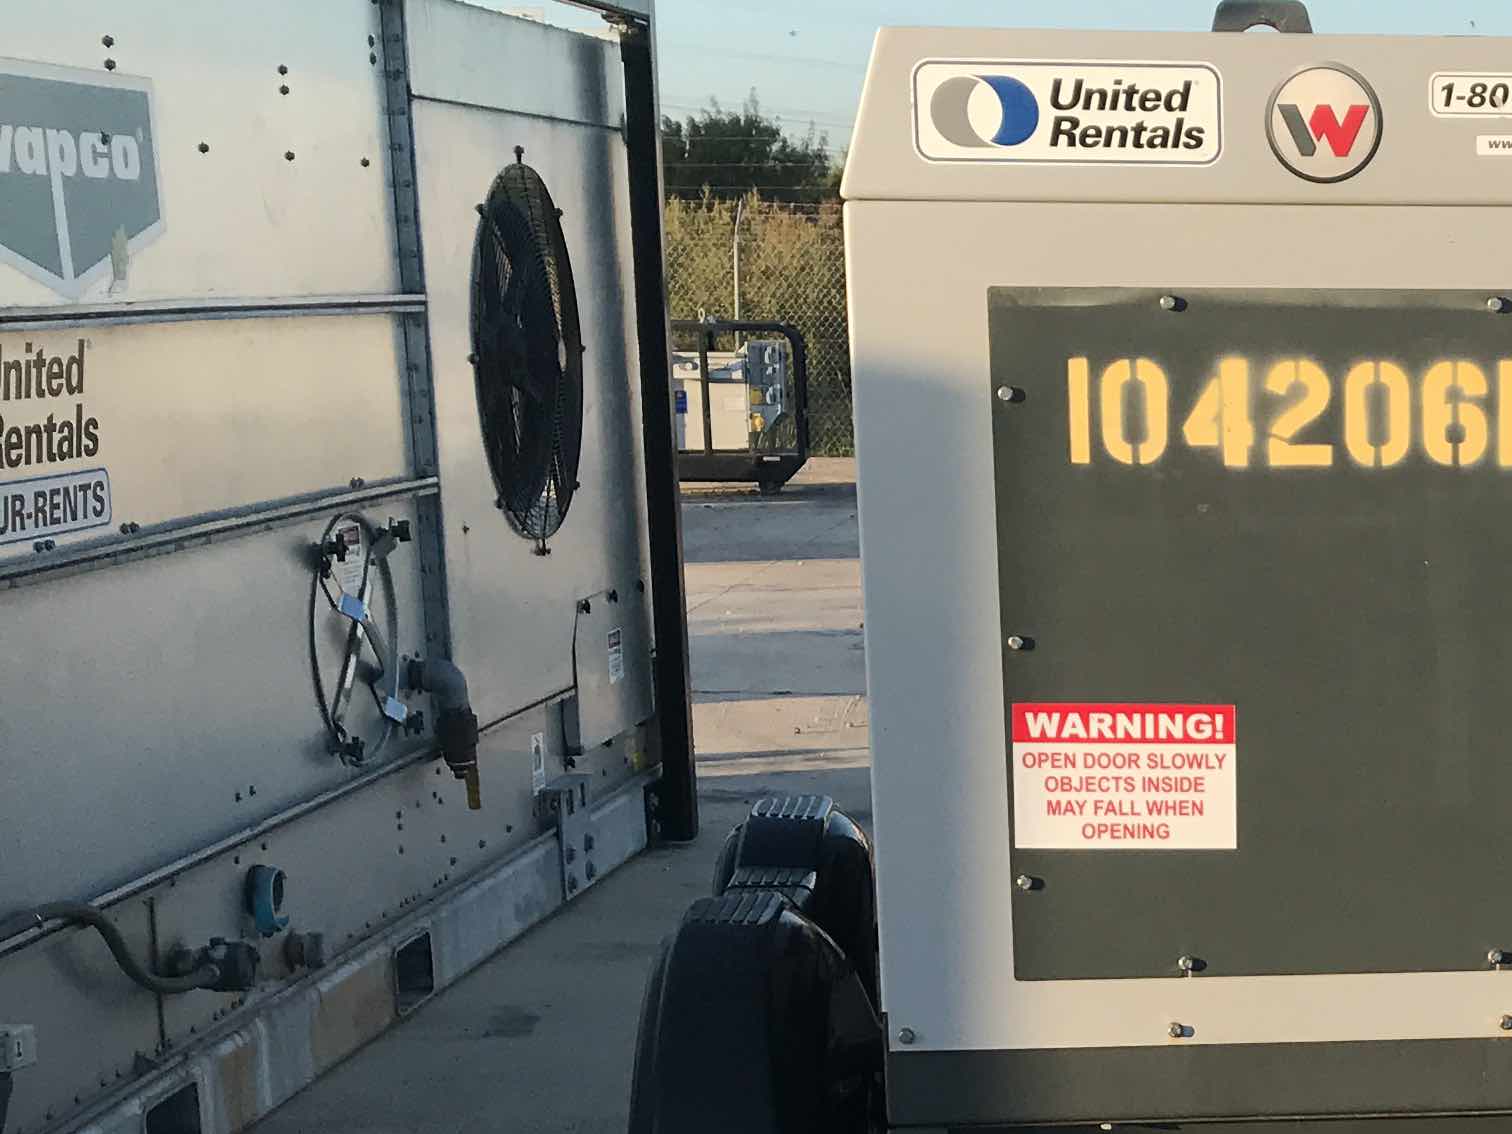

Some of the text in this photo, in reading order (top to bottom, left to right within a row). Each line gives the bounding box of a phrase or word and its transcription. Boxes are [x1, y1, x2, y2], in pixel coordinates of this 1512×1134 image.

[1049, 78, 1192, 112] United
[1050, 115, 1205, 149] Rentals
[0, 339, 85, 401] nited
[0, 403, 99, 470] entals
[1024, 712, 1224, 739] WARNING!
[1022, 753, 1226, 770] OPEN DOOR SLOWLY
[1044, 776, 1205, 793] OBJECTS INSIDE
[1046, 800, 1204, 817] MAY FALL WHEN
[1081, 823, 1170, 840] OPENING
